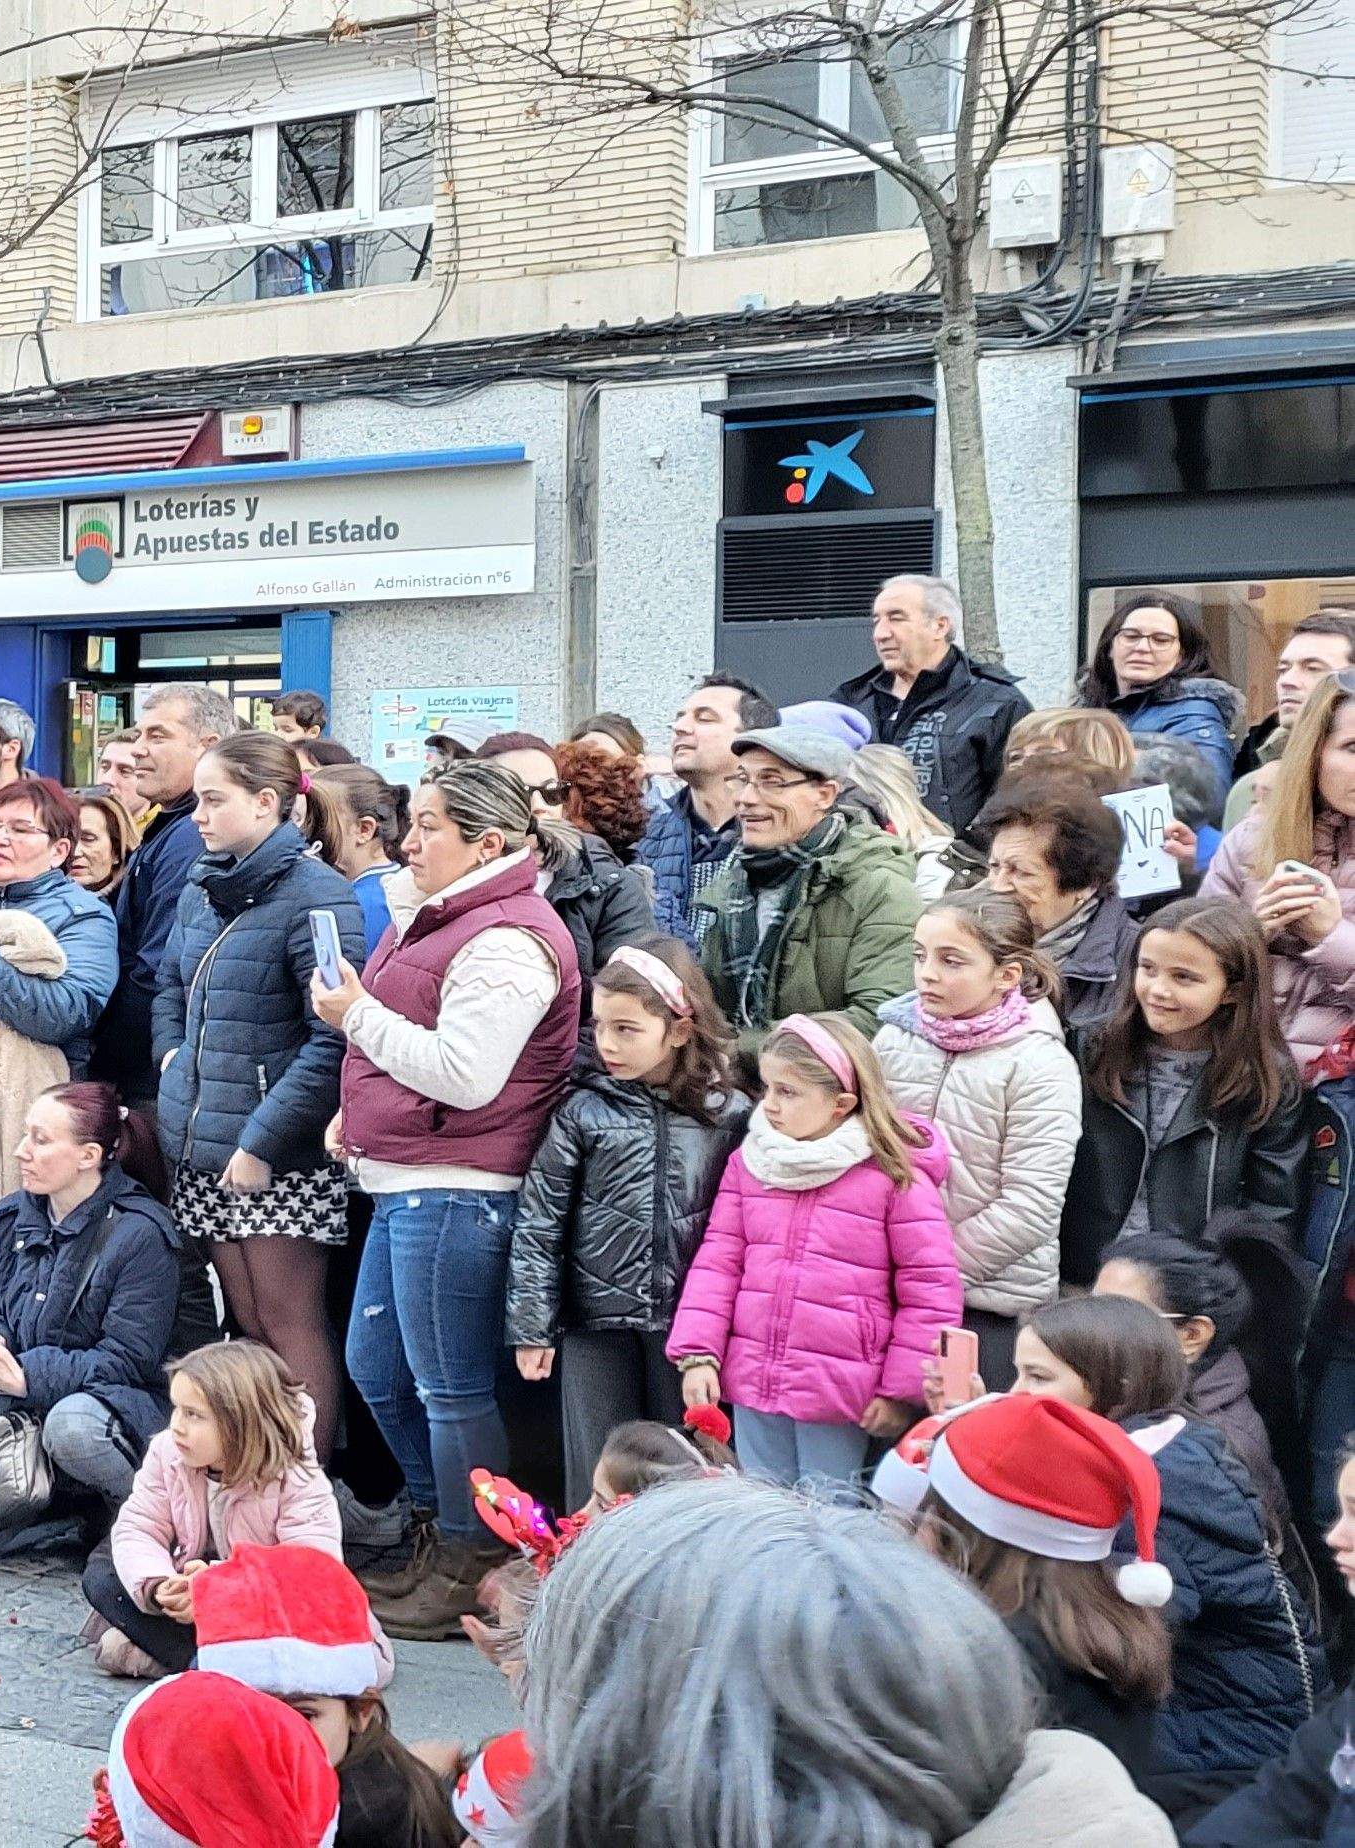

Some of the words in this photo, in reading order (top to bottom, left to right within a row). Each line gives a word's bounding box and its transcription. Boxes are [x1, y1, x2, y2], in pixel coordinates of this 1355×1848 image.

[133, 492, 236, 523] Loterías
[244, 496, 260, 522] y
[133, 527, 250, 561] Apuestas
[259, 521, 298, 548] del
[308, 515, 400, 545] Estado
[255, 582, 308, 596] Alfonso
[374, 572, 483, 589] Administración
